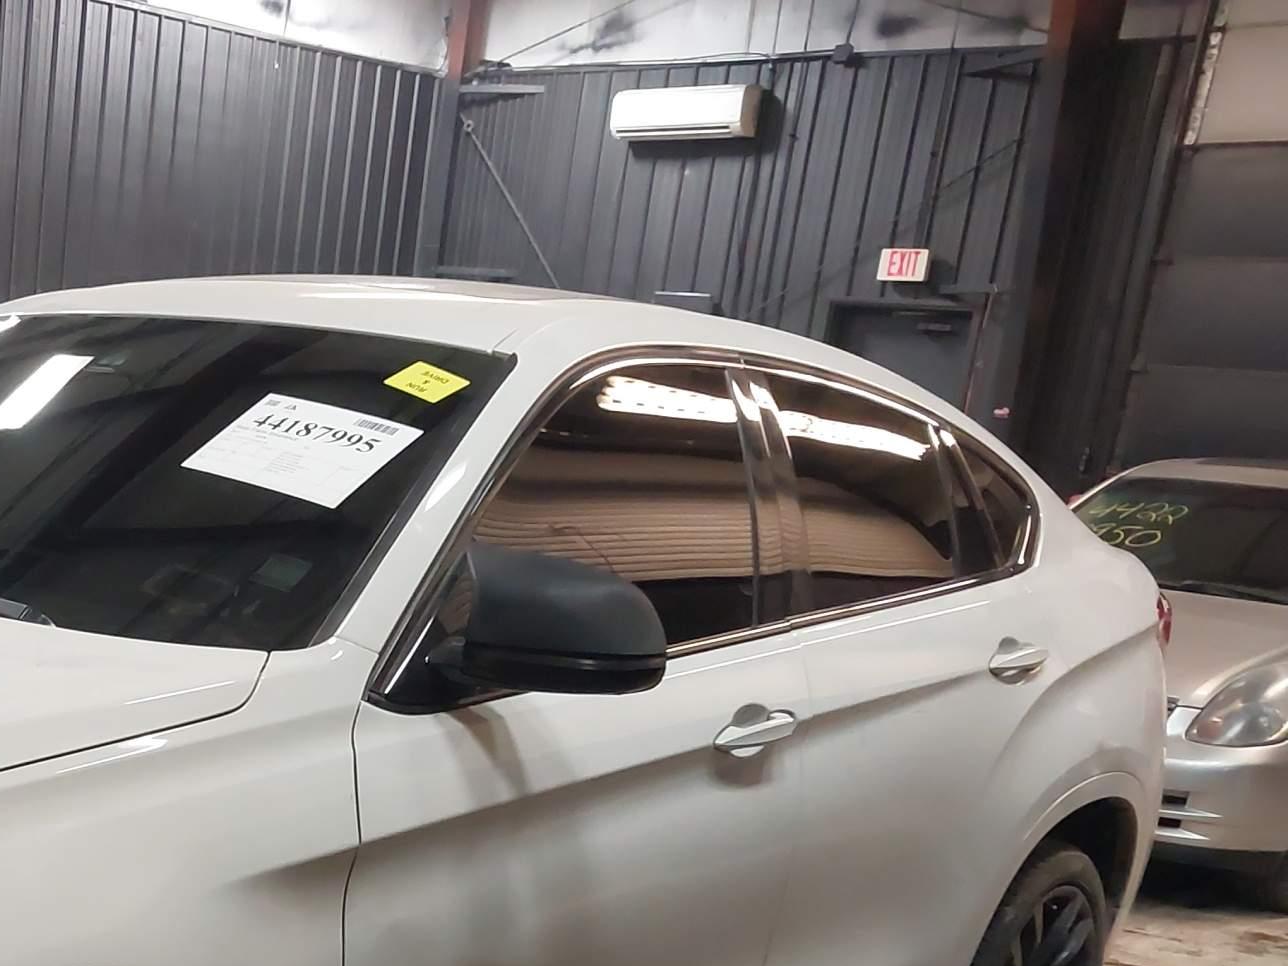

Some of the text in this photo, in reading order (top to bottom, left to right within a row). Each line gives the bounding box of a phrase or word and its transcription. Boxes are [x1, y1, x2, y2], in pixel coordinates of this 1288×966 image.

[887, 251, 921, 276] EXIT
[406, 382, 428, 393] RUN
[253, 414, 382, 453] 44187995
